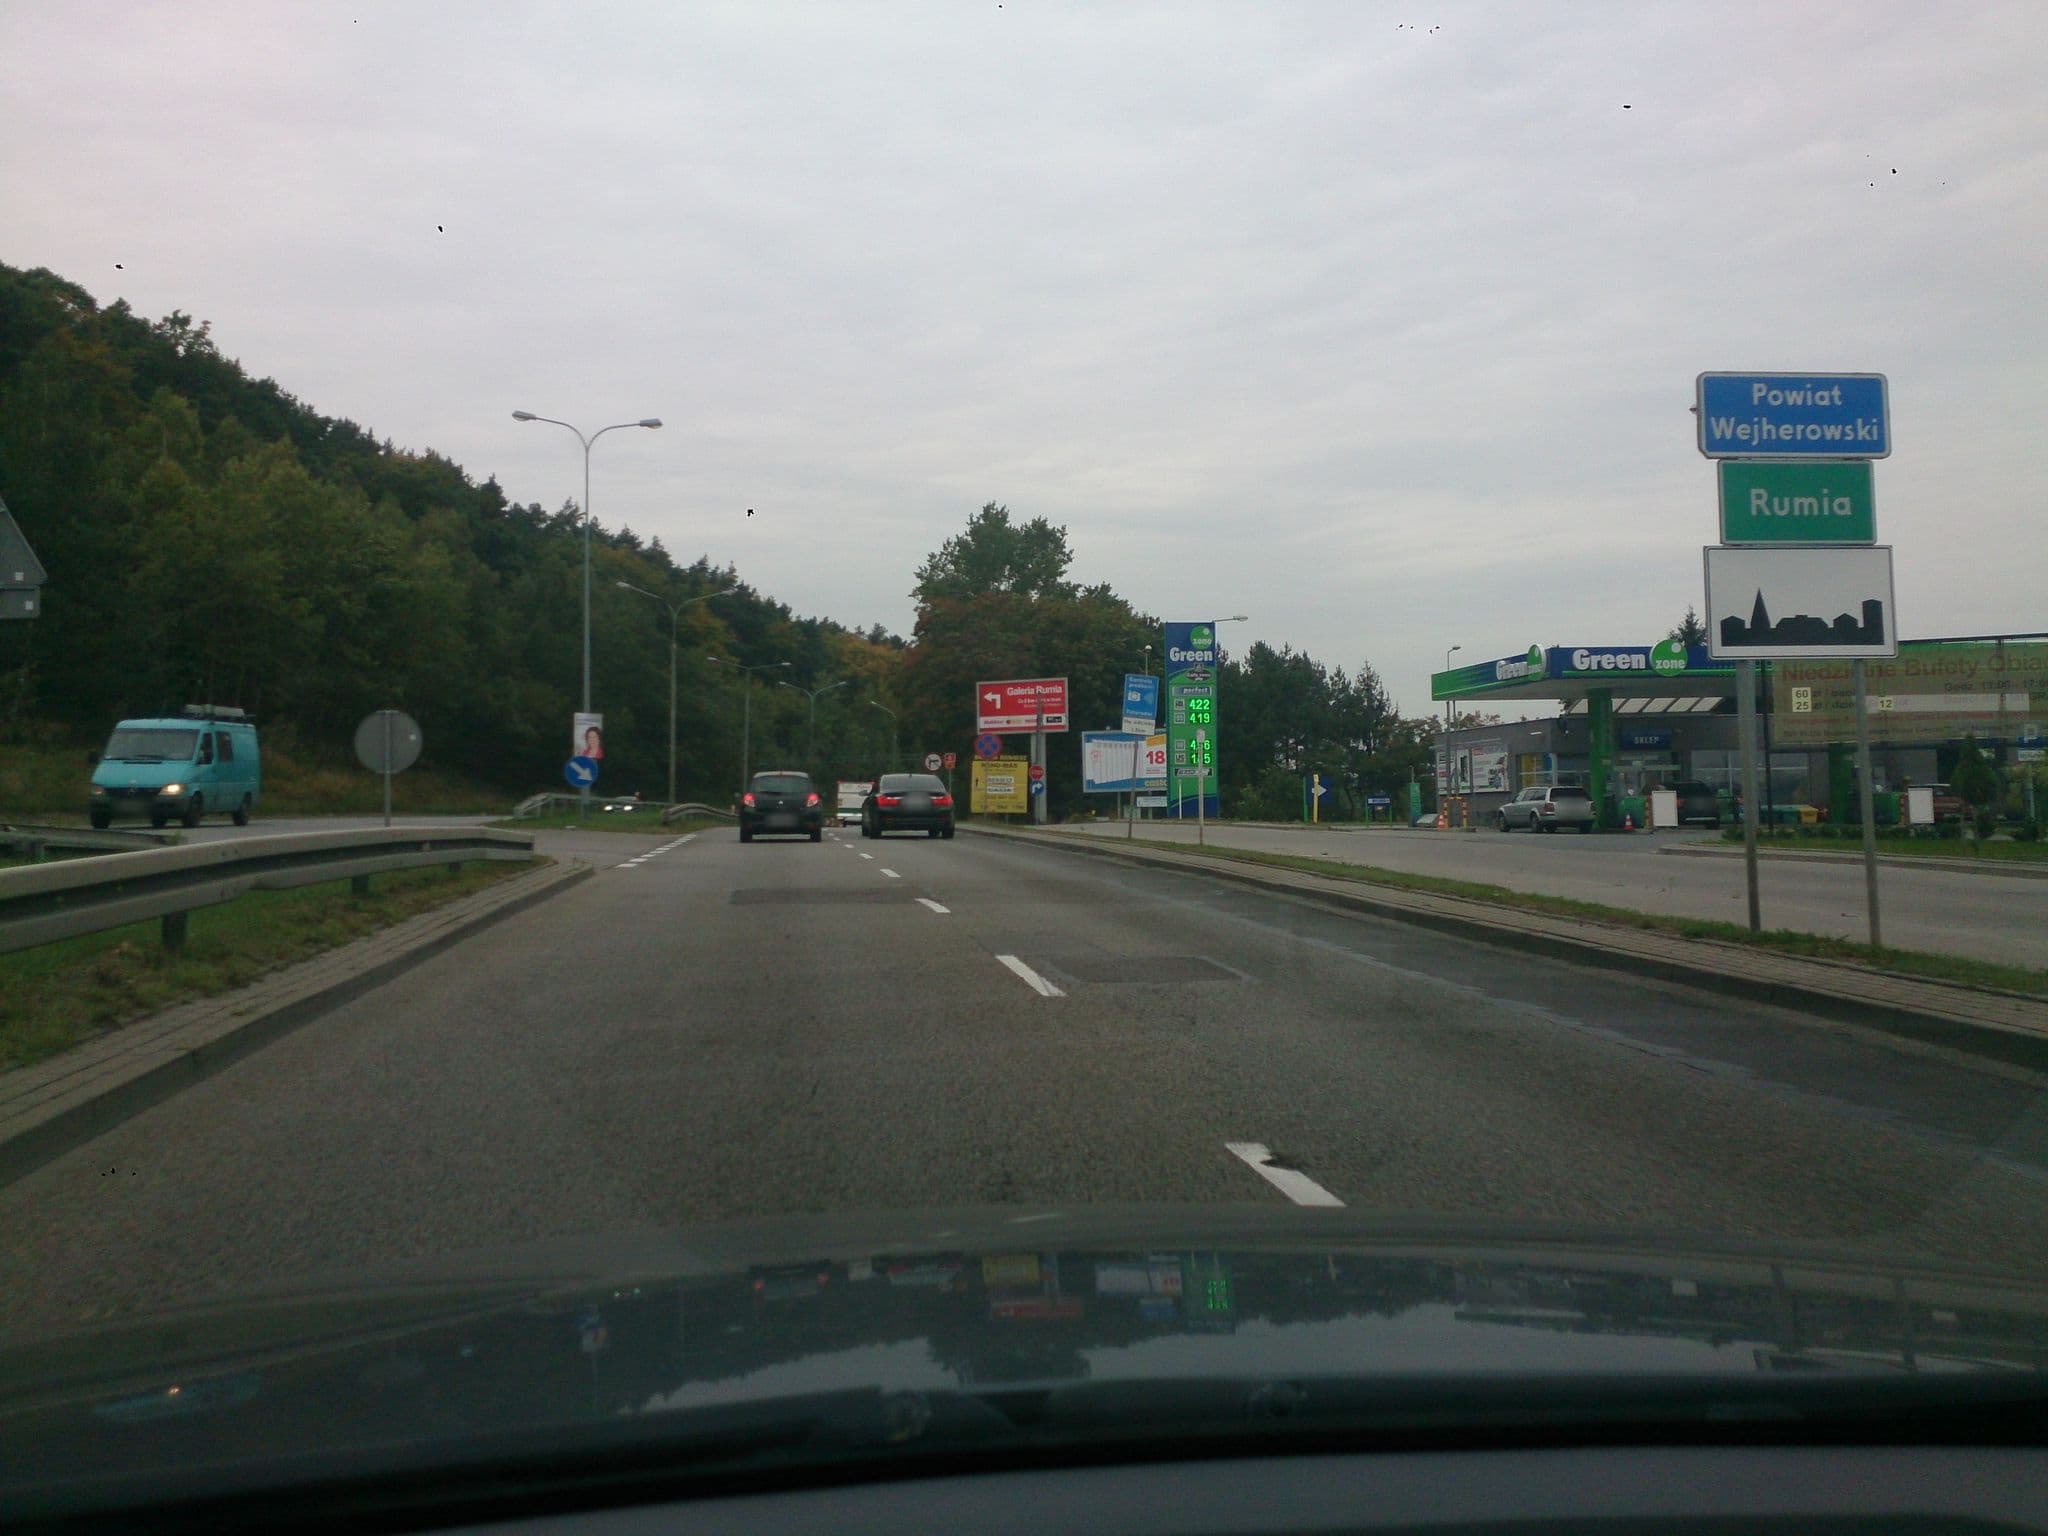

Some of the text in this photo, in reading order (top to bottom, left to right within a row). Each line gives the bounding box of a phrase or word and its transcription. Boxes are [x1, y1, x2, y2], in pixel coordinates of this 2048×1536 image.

[1752, 383, 1842, 406] Powiat
[1711, 416, 1879, 446] Wejherowski
[1750, 488, 1852, 516] Rumia
[1169, 647, 1213, 662] Green
[1572, 649, 1686, 671] Green zone
[1496, 660, 1528, 681] Green
[1007, 685, 1063, 696] Galeria Rumia
[1795, 689, 1809, 699] 60
[1189, 699, 1210, 710] 422
[1796, 701, 1810, 710] 25
[1880, 699, 1893, 709] 12
[1190, 712, 1210, 724] 419
[1190, 740, 1211, 750] 46
[1146, 750, 1166, 765] 18
[1191, 753, 1211, 764] 15
